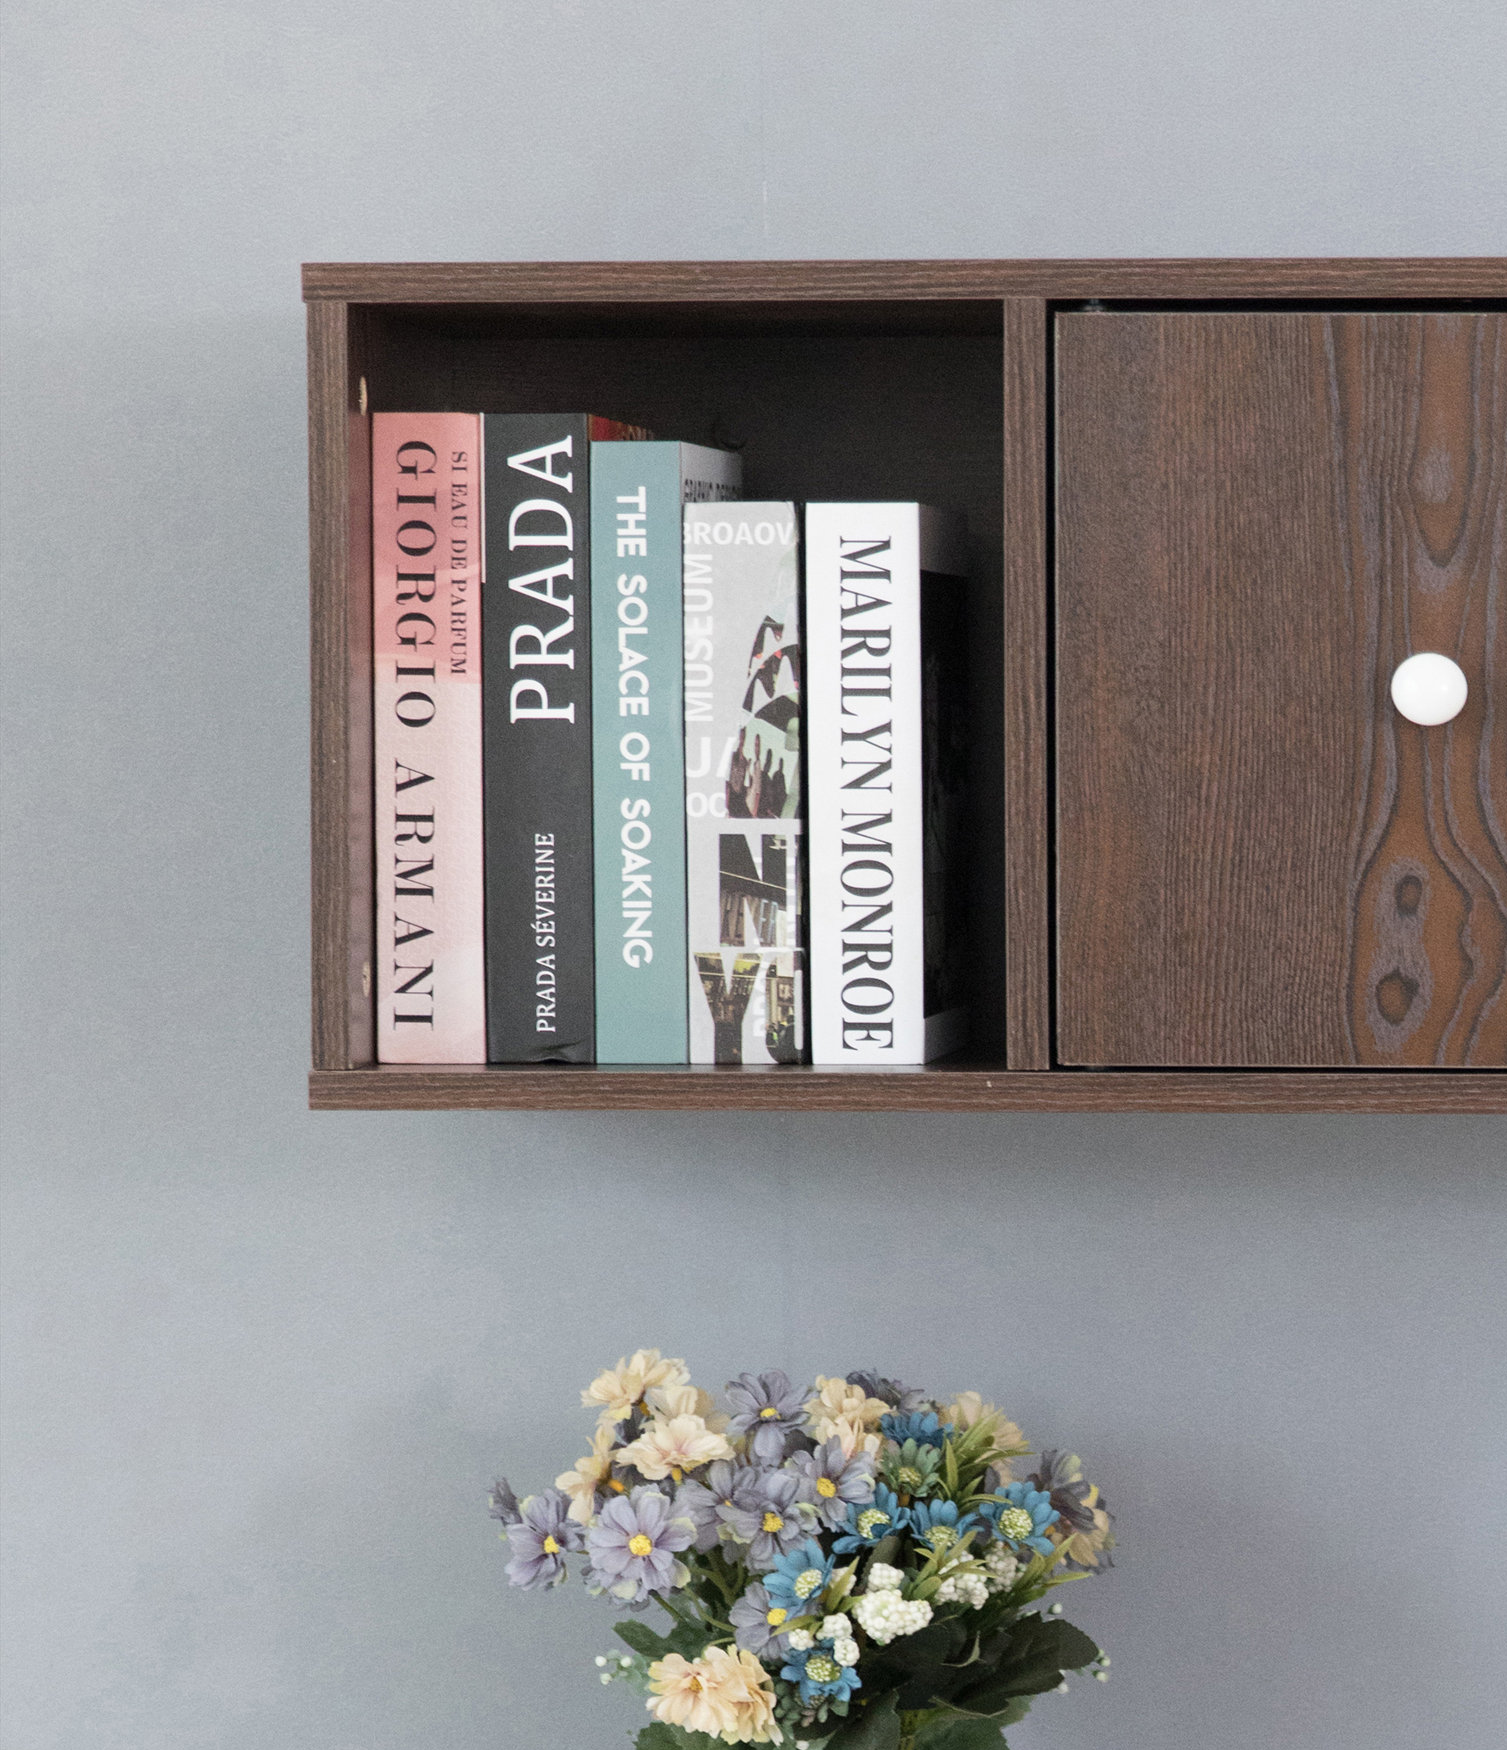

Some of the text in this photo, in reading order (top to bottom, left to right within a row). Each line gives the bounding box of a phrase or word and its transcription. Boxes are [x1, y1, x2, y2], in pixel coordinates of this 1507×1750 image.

[450, 450, 468, 675] SI EAU DE PARFUM
[507, 434, 575, 724] PRADA
[684, 554, 714, 722] MUSEUM
[392, 440, 438, 1031] GIORGIO ARMANI
[616, 486, 655, 969] THE SOLACE OF SOAKING
[839, 535, 895, 1051] MARILYN MONROE
[530, 833, 556, 1032] PRADA SÉVERINE
